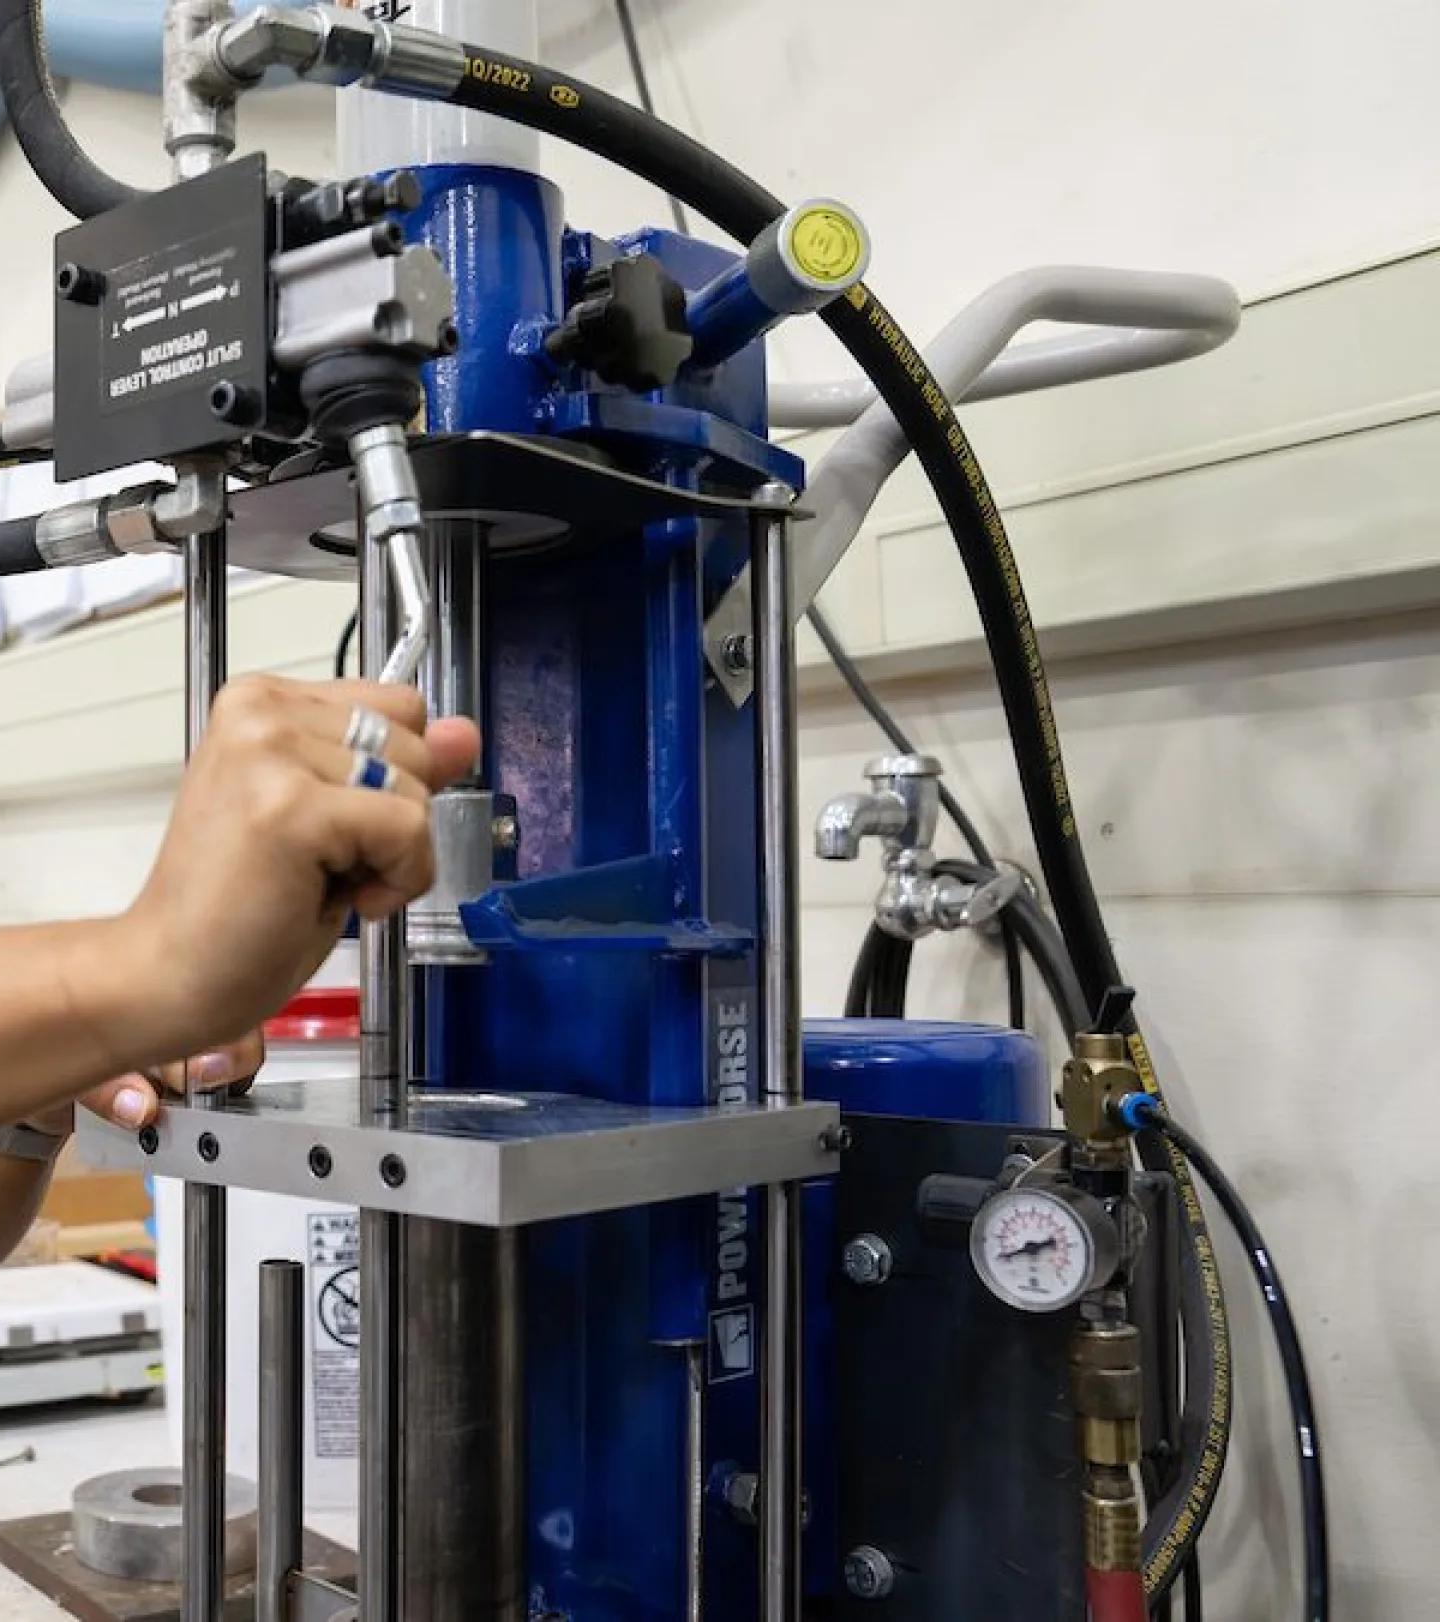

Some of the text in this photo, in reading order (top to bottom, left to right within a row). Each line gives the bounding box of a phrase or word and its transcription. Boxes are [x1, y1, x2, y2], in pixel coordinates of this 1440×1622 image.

[109, 340, 243, 397] SPLIT CONTROL LEVER
[141, 328, 208, 366] OPERATION
